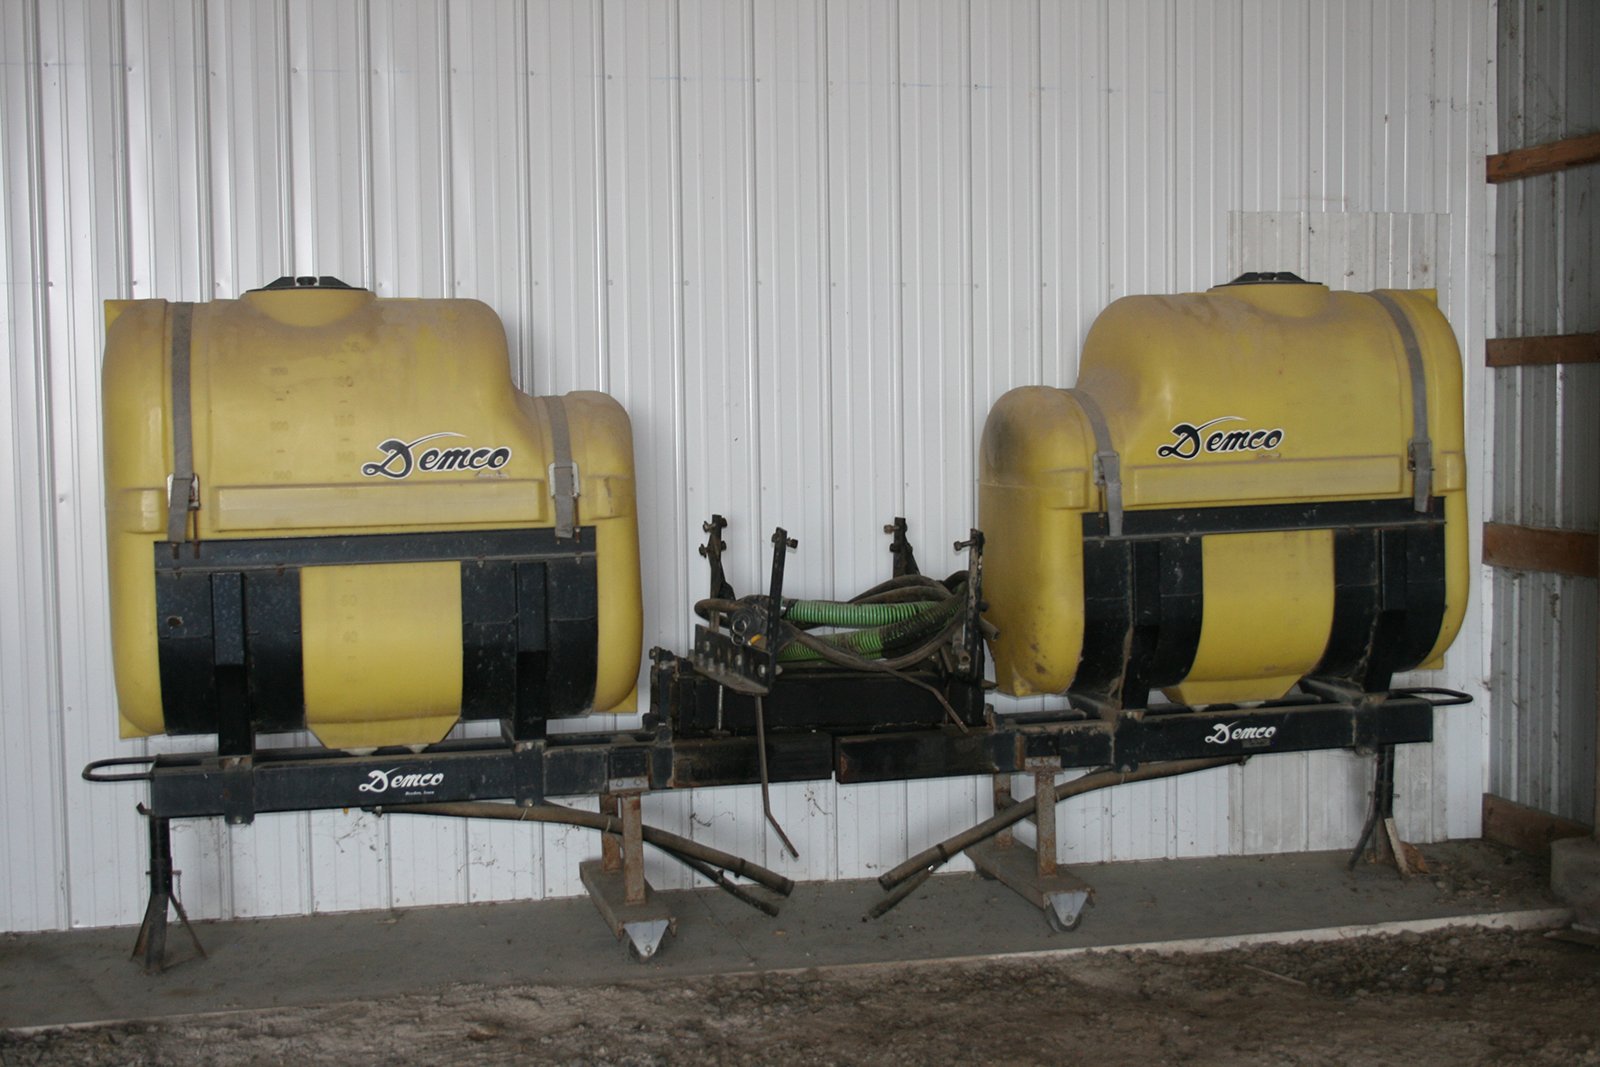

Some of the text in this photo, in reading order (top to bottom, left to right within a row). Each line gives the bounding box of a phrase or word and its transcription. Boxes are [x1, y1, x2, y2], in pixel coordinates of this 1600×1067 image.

[1156, 416, 1284, 460] Demco
[361, 432, 511, 479] Demco
[1205, 721, 1276, 744] Demco
[358, 767, 444, 792] Demco
